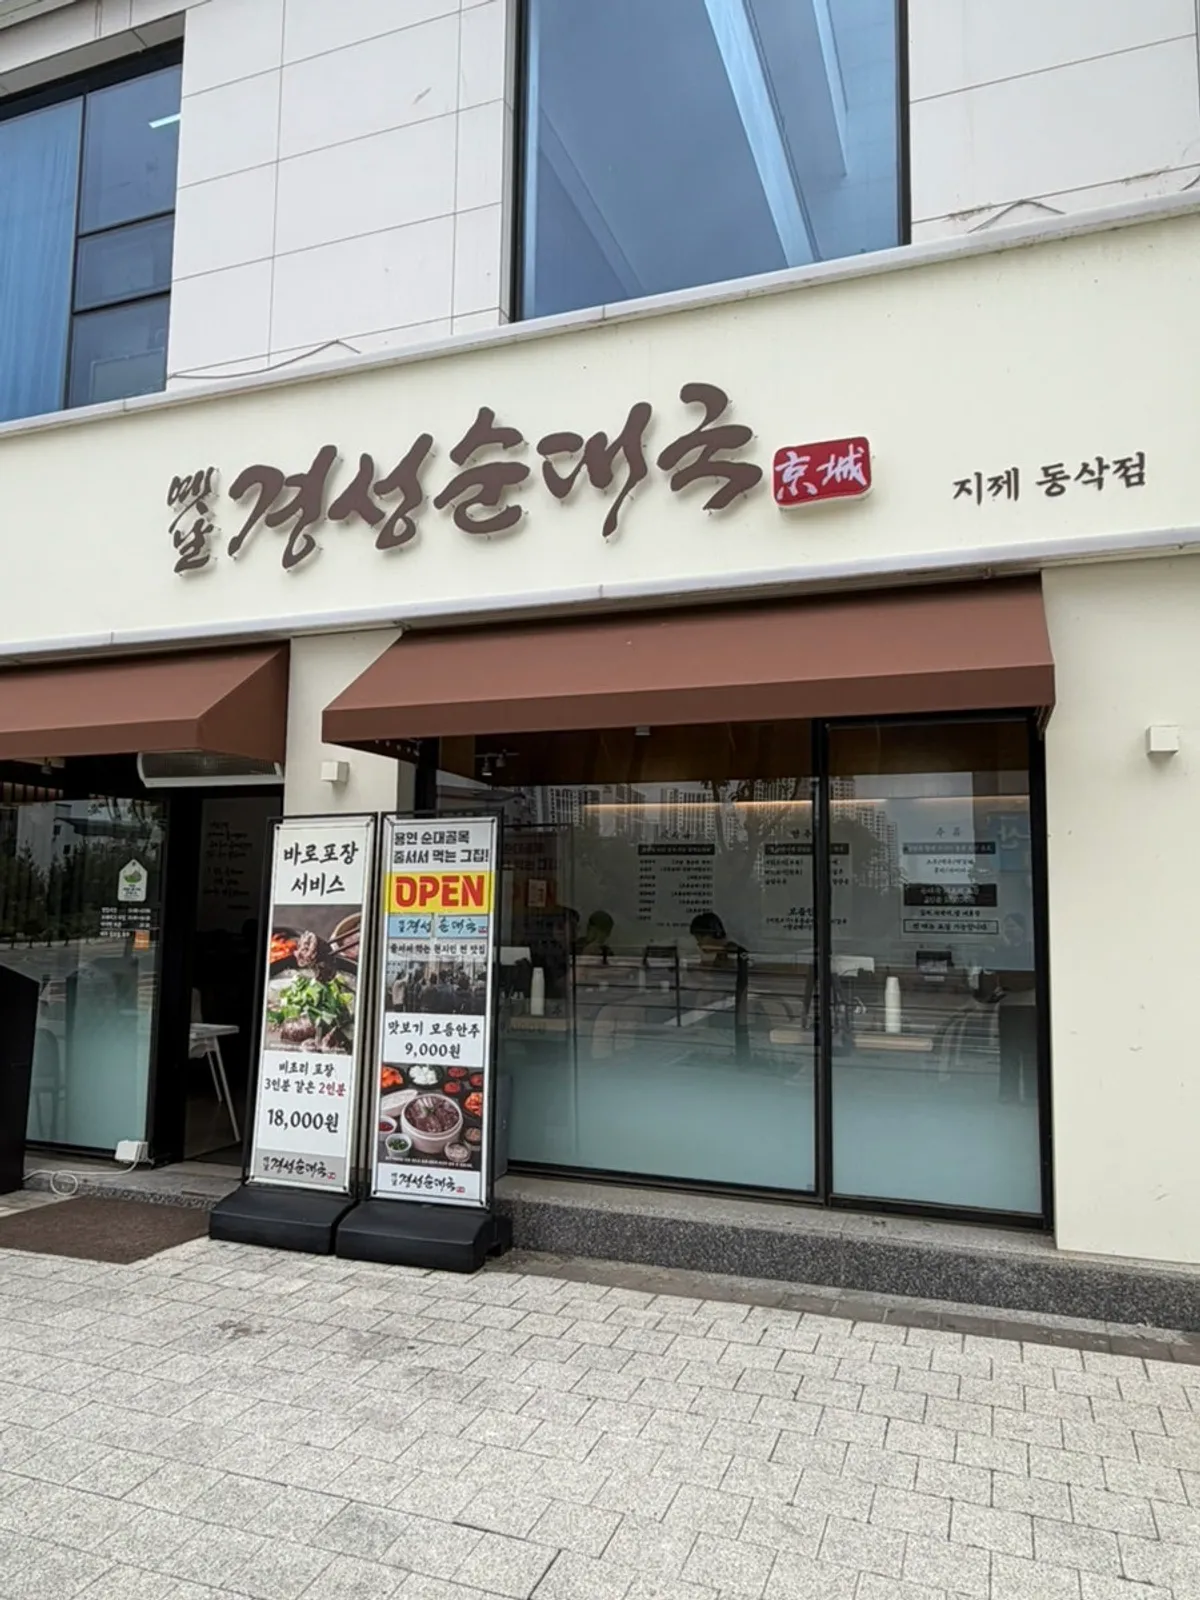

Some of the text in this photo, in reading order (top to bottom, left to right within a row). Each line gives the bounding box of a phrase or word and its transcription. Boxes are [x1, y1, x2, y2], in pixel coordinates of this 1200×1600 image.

[228, 383, 763, 571] 경성순대국
[774, 443, 868, 500] 京城
[953, 451, 1146, 506] 지제 동삭점
[421, 830, 470, 845] 순대골목
[283, 840, 359, 866] 바로포장
[432, 850, 457, 863] 먹는
[290, 872, 346, 897] 서비스
[395, 875, 485, 908] OPEN
[388, 1020, 424, 1036] 맛보기
[404, 1042, 461, 1059] 9,000원
[313, 1063, 334, 1078] 포장
[264, 1078, 347, 1097] 3인분 같은 2인분
[267, 1108, 340, 1134] 18,000원
